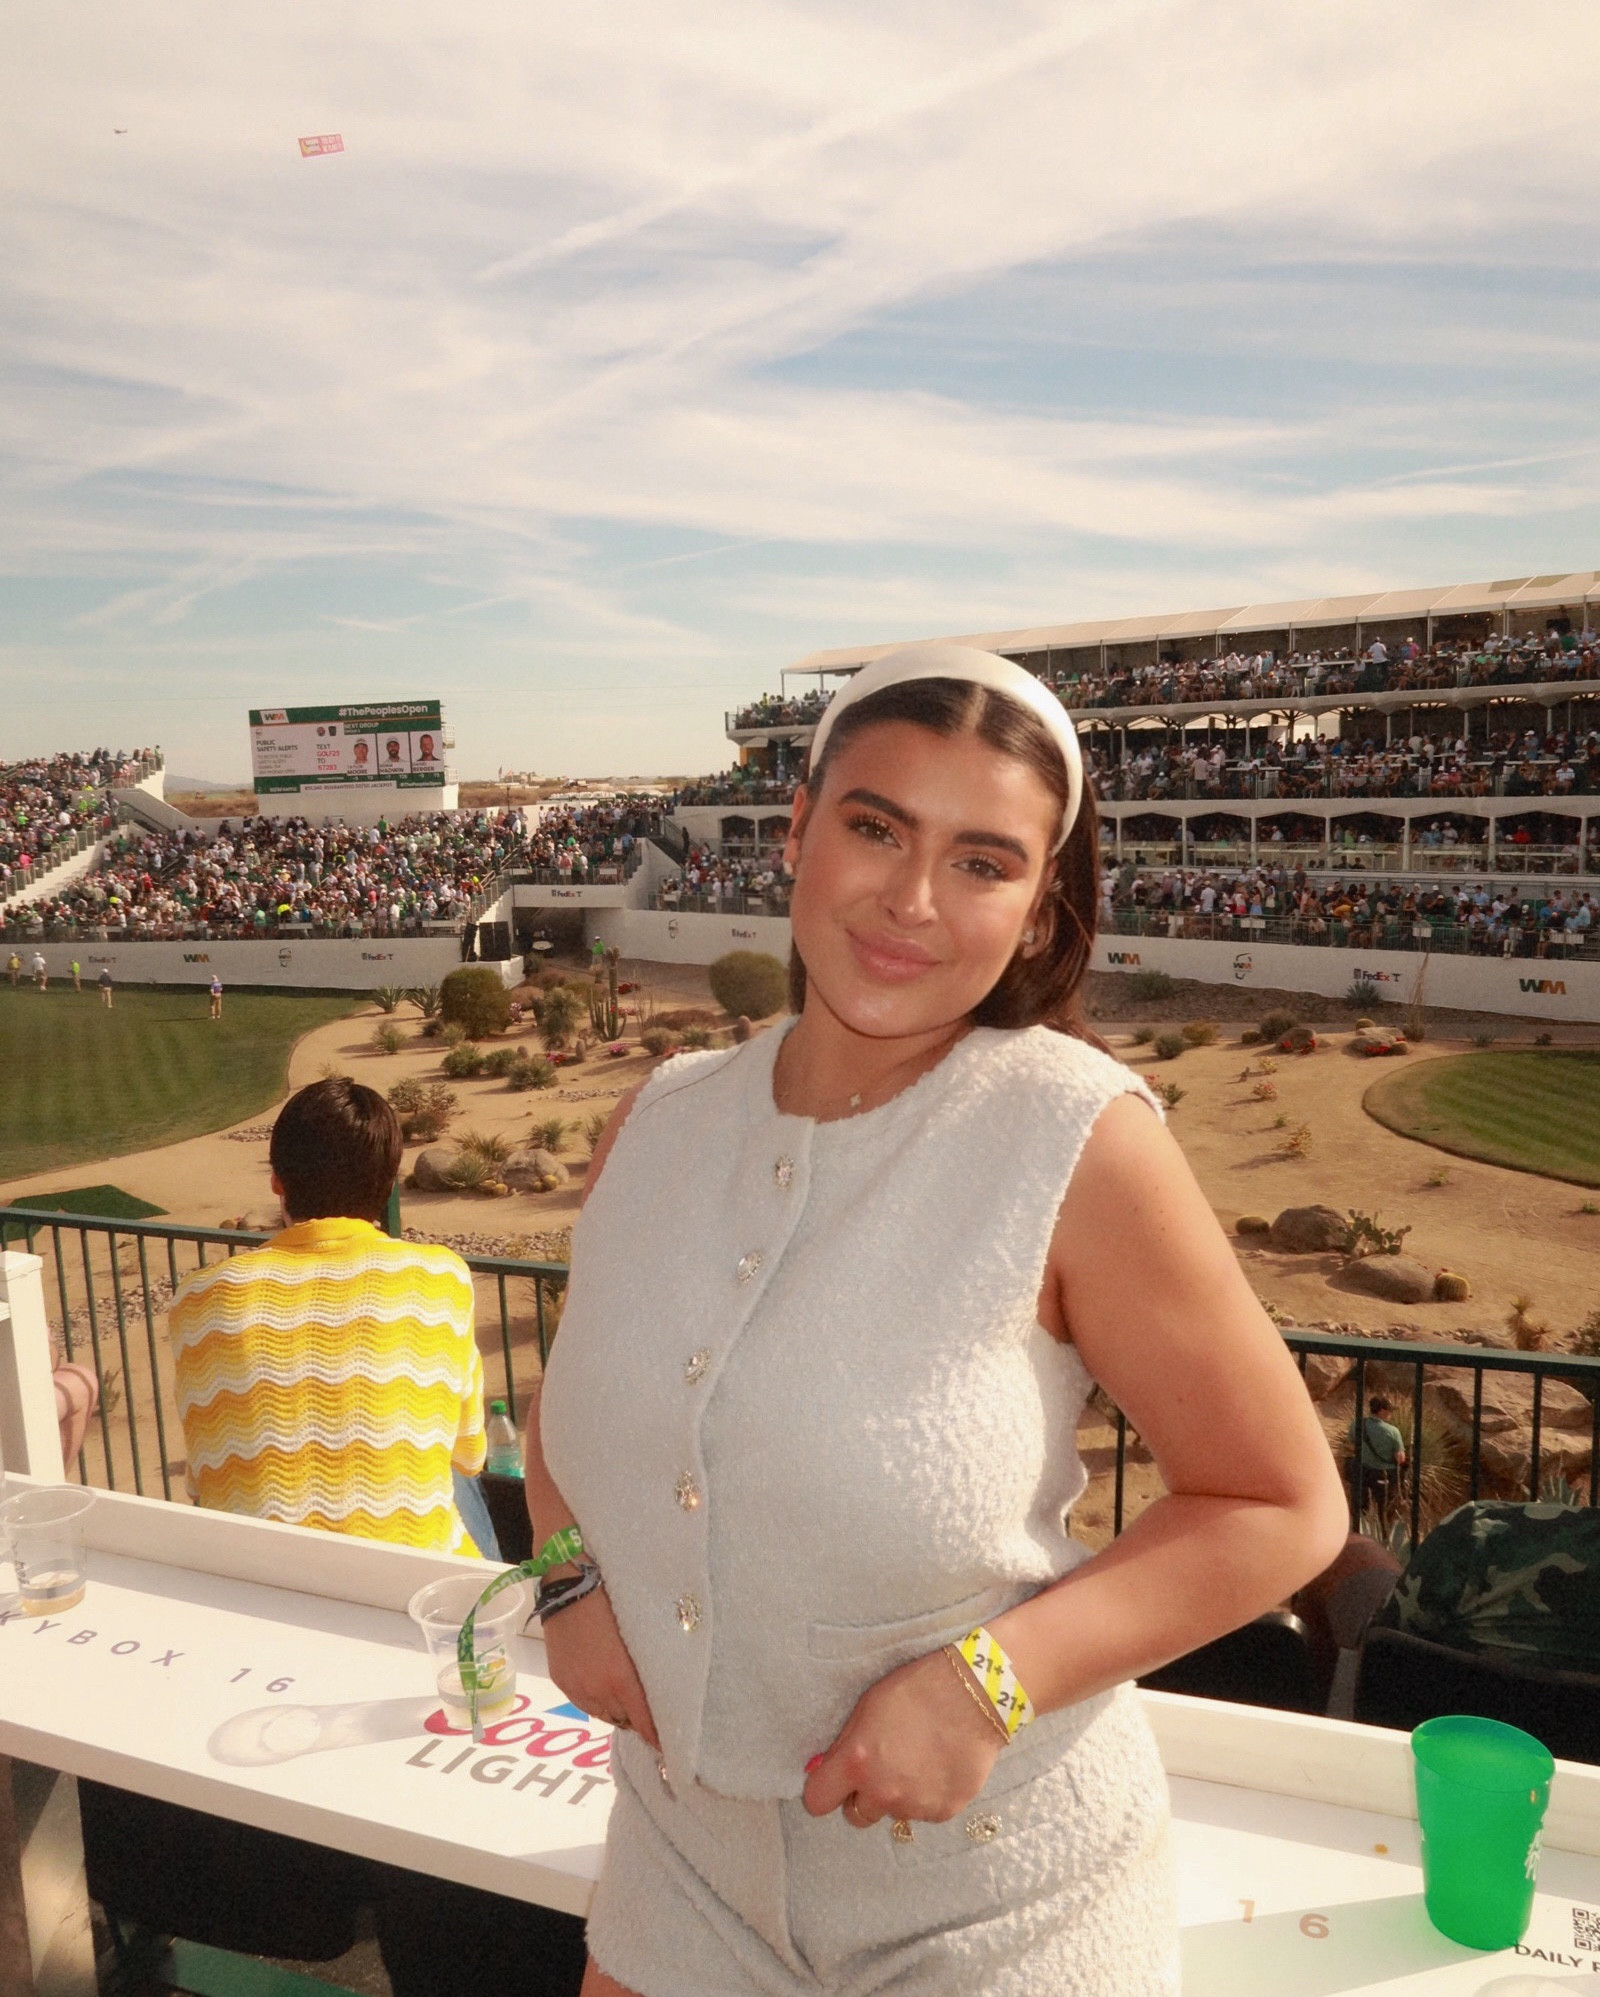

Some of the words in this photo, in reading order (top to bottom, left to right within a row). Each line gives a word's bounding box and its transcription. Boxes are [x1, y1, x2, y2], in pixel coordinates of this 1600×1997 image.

[338, 705, 428, 717] #ThePeoplesOpen
[183, 954, 210, 963] WM
[1107, 952, 1141, 965] WM
[1233, 962, 1252, 970] WM
[1362, 970, 1390, 982] FedEx
[1519, 978, 1566, 996] WM
[972, 1653, 1004, 1676] 21+
[230, 1667, 296, 1693] 16
[996, 1691, 1026, 1712] 21+
[424, 1694, 614, 1775] Coor
[405, 1738, 611, 1806] LIGHT
[1238, 1899, 1330, 1939] 16
[1514, 1943, 1583, 1968] DAILY
